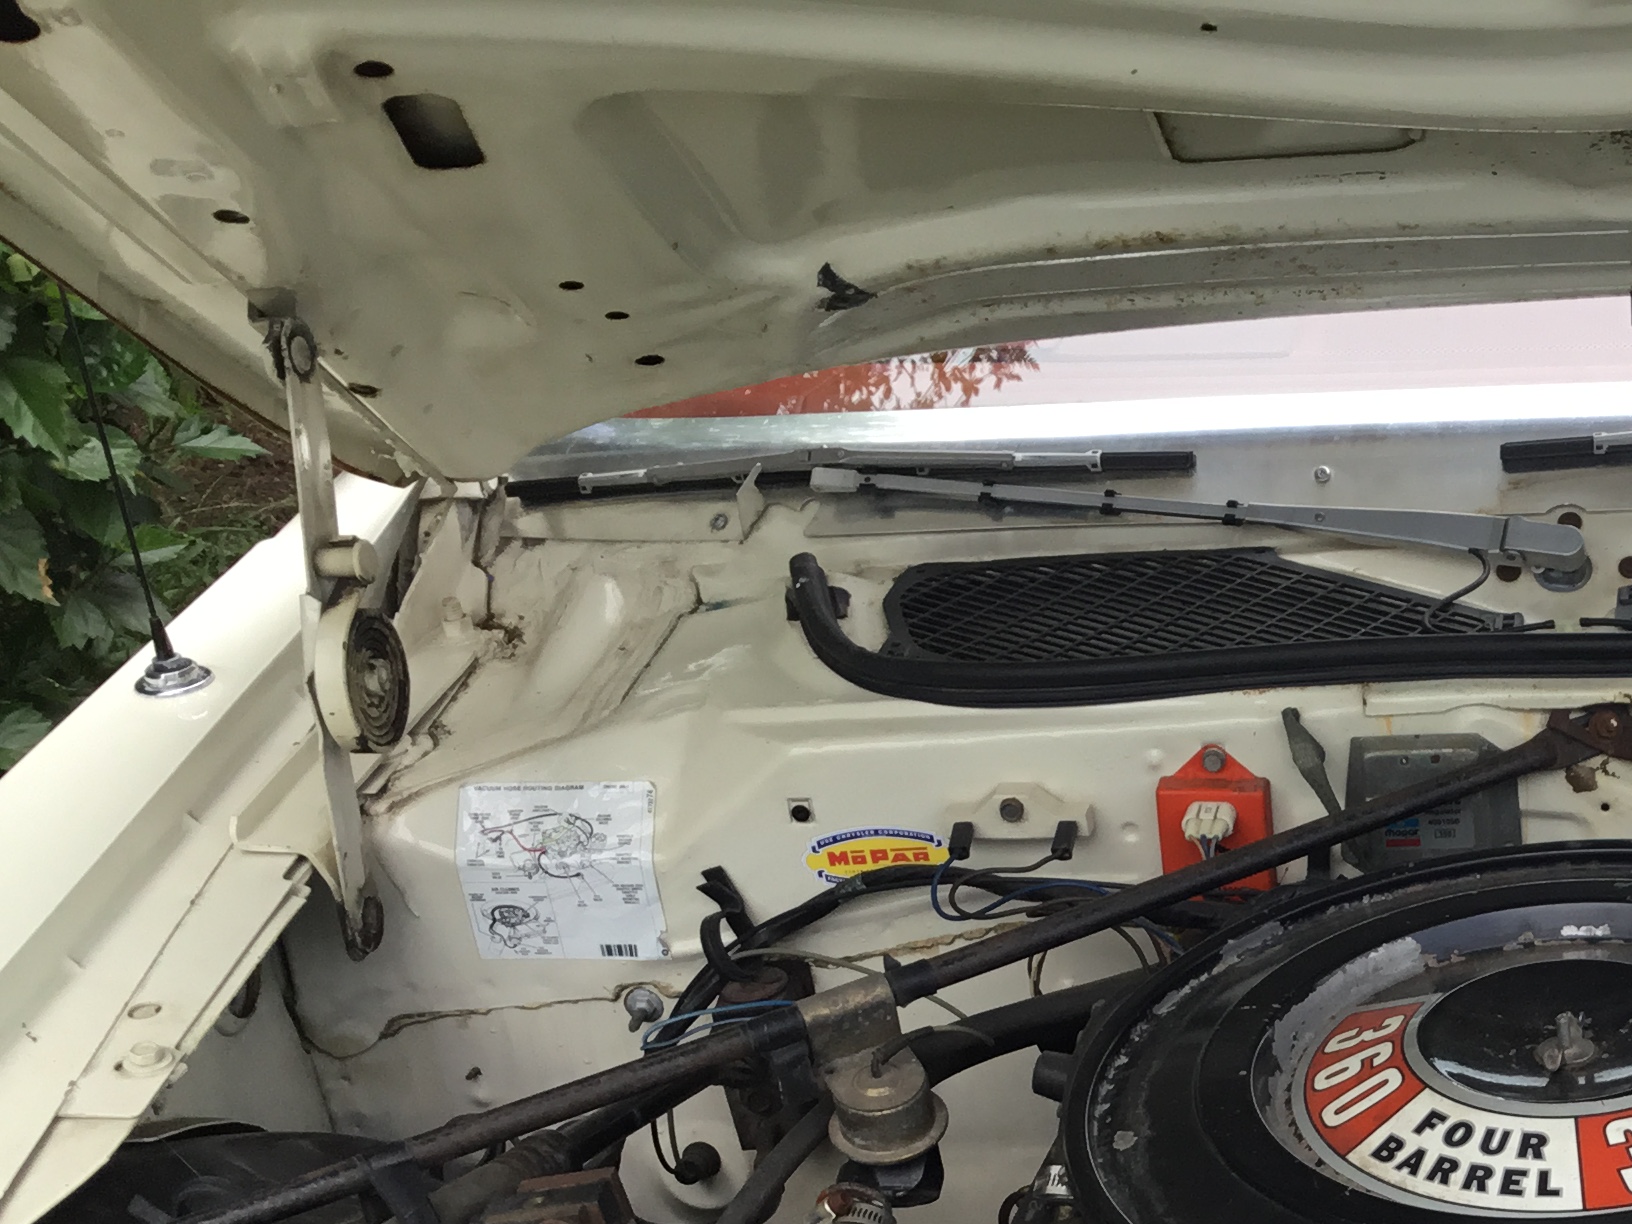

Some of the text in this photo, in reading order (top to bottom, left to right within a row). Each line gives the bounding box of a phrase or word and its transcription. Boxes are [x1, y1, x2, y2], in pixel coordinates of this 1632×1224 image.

[1312, 1013, 1406, 1129] 360
[1371, 1134, 1565, 1200] BARREL
[1414, 1108, 1550, 1162] FOUR
